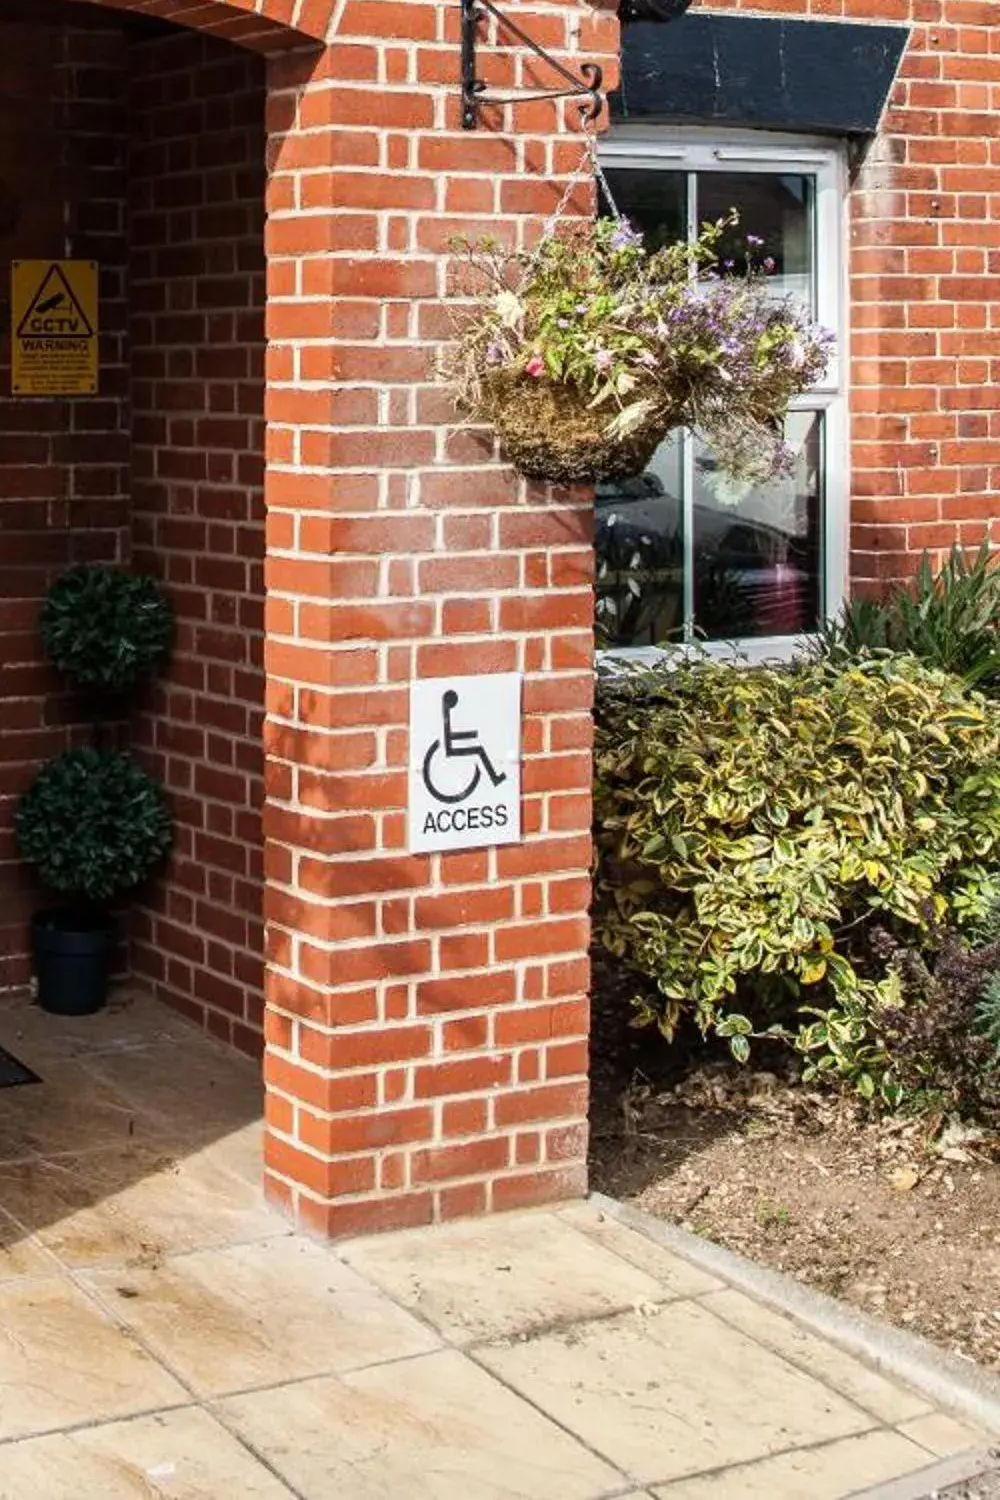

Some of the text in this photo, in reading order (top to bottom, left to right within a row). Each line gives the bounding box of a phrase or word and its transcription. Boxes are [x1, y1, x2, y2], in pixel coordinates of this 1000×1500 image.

[30, 318, 79, 332] CCTV
[21, 339, 88, 351] WARNING
[423, 804, 508, 834] ACCESS
